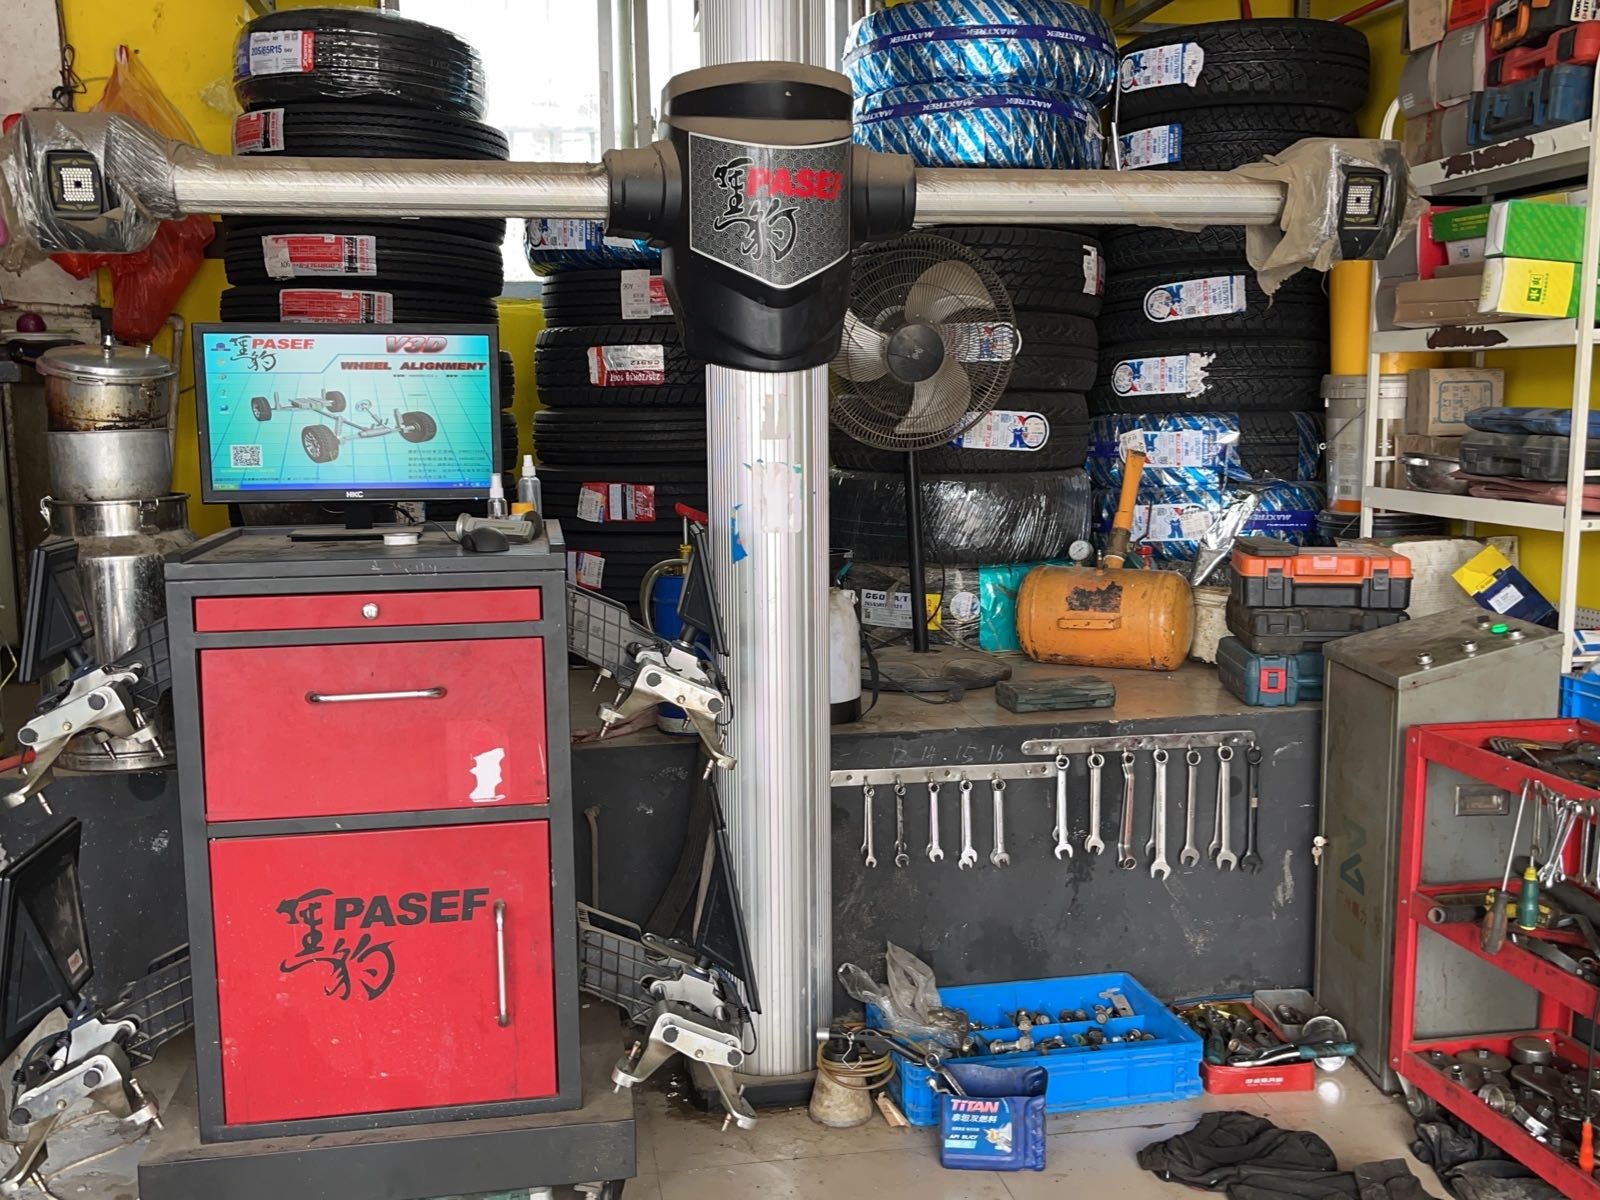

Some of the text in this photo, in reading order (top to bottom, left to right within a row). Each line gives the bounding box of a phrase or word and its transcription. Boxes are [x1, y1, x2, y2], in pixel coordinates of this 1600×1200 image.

[889, 30, 935, 44] MAXTREK
[964, 26, 1018, 38] MAXTREK
[1046, 30, 1086, 42] MAXTREK
[922, 99, 975, 111] MAXTREK
[1004, 98, 1052, 109] MAXTREK
[252, 338, 314, 350] PASEF
[385, 336, 448, 354] V3D
[340, 362, 486, 370] WHEEL ALIGNMENT
[988, 744, 1004, 761] 16
[334, 888, 490, 930] PASEF
